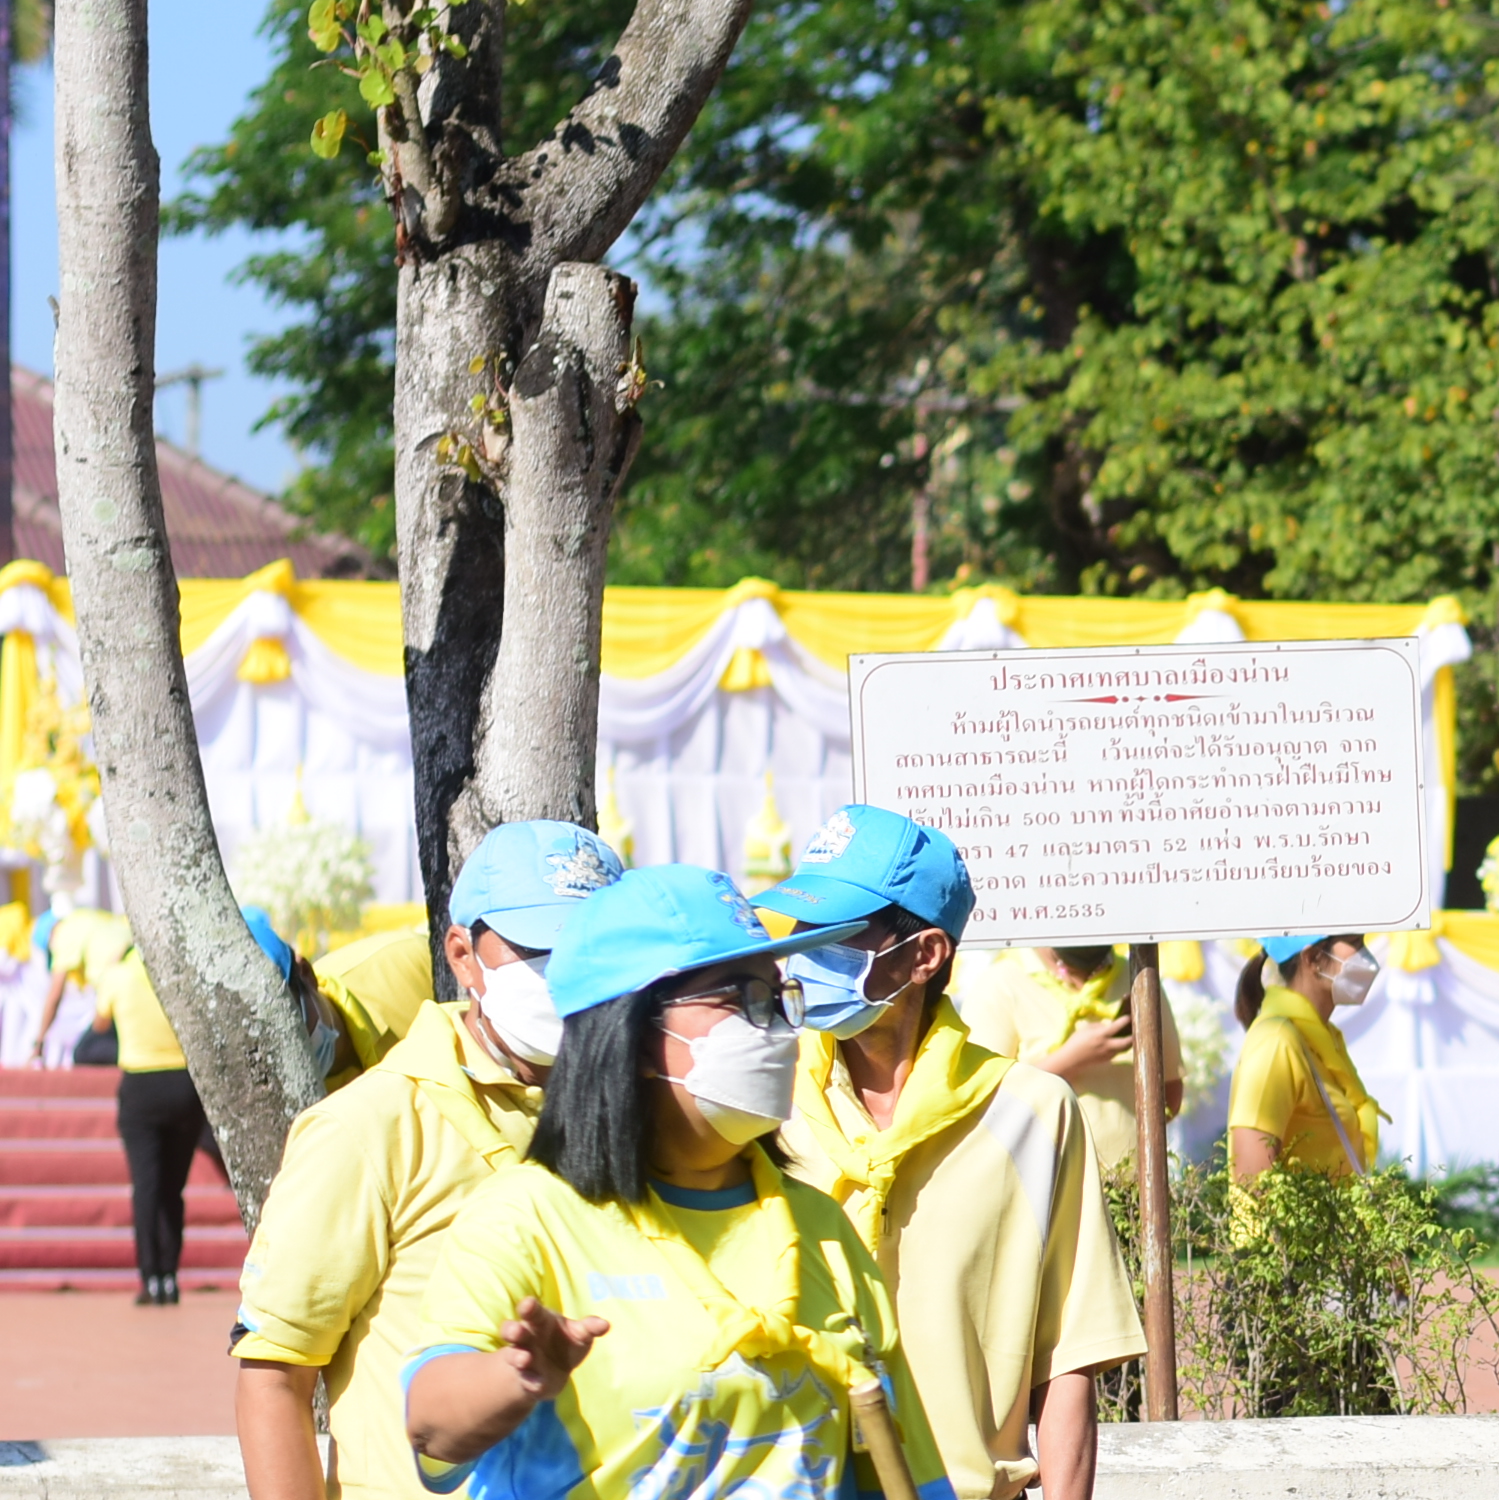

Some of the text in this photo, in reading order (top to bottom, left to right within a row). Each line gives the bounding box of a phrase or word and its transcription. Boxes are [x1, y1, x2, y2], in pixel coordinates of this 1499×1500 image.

[990, 657, 1290, 692] ประกาศเทศบาลเมืองน่าน
[950, 701, 1375, 742] ห้ามผู้ใดนำรถยนต์ทุกชนิดเข้ามาในบริเวณ
[896, 732, 1377, 768] สถานสาธารณะนี้ เว้นแต่จะได้รับอนุญาต จาก
[896, 761, 1393, 800] เทศบาลเมืองน่าน หากผู้ใดกระทำการฝ่าฝืนมีโทษ
[1023, 811, 1061, 827] 500
[1071, 812, 1113, 826] บาท
[957, 825, 1371, 860] ตรา 47 และมาตรา 52 แห่ง พ.ร.บ.รักษา
[972, 854, 1392, 891] ะอาด และความเป็นระเบียบเรียบร้อยของ
[1010, 902, 1106, 922] พ.ศ.2535
